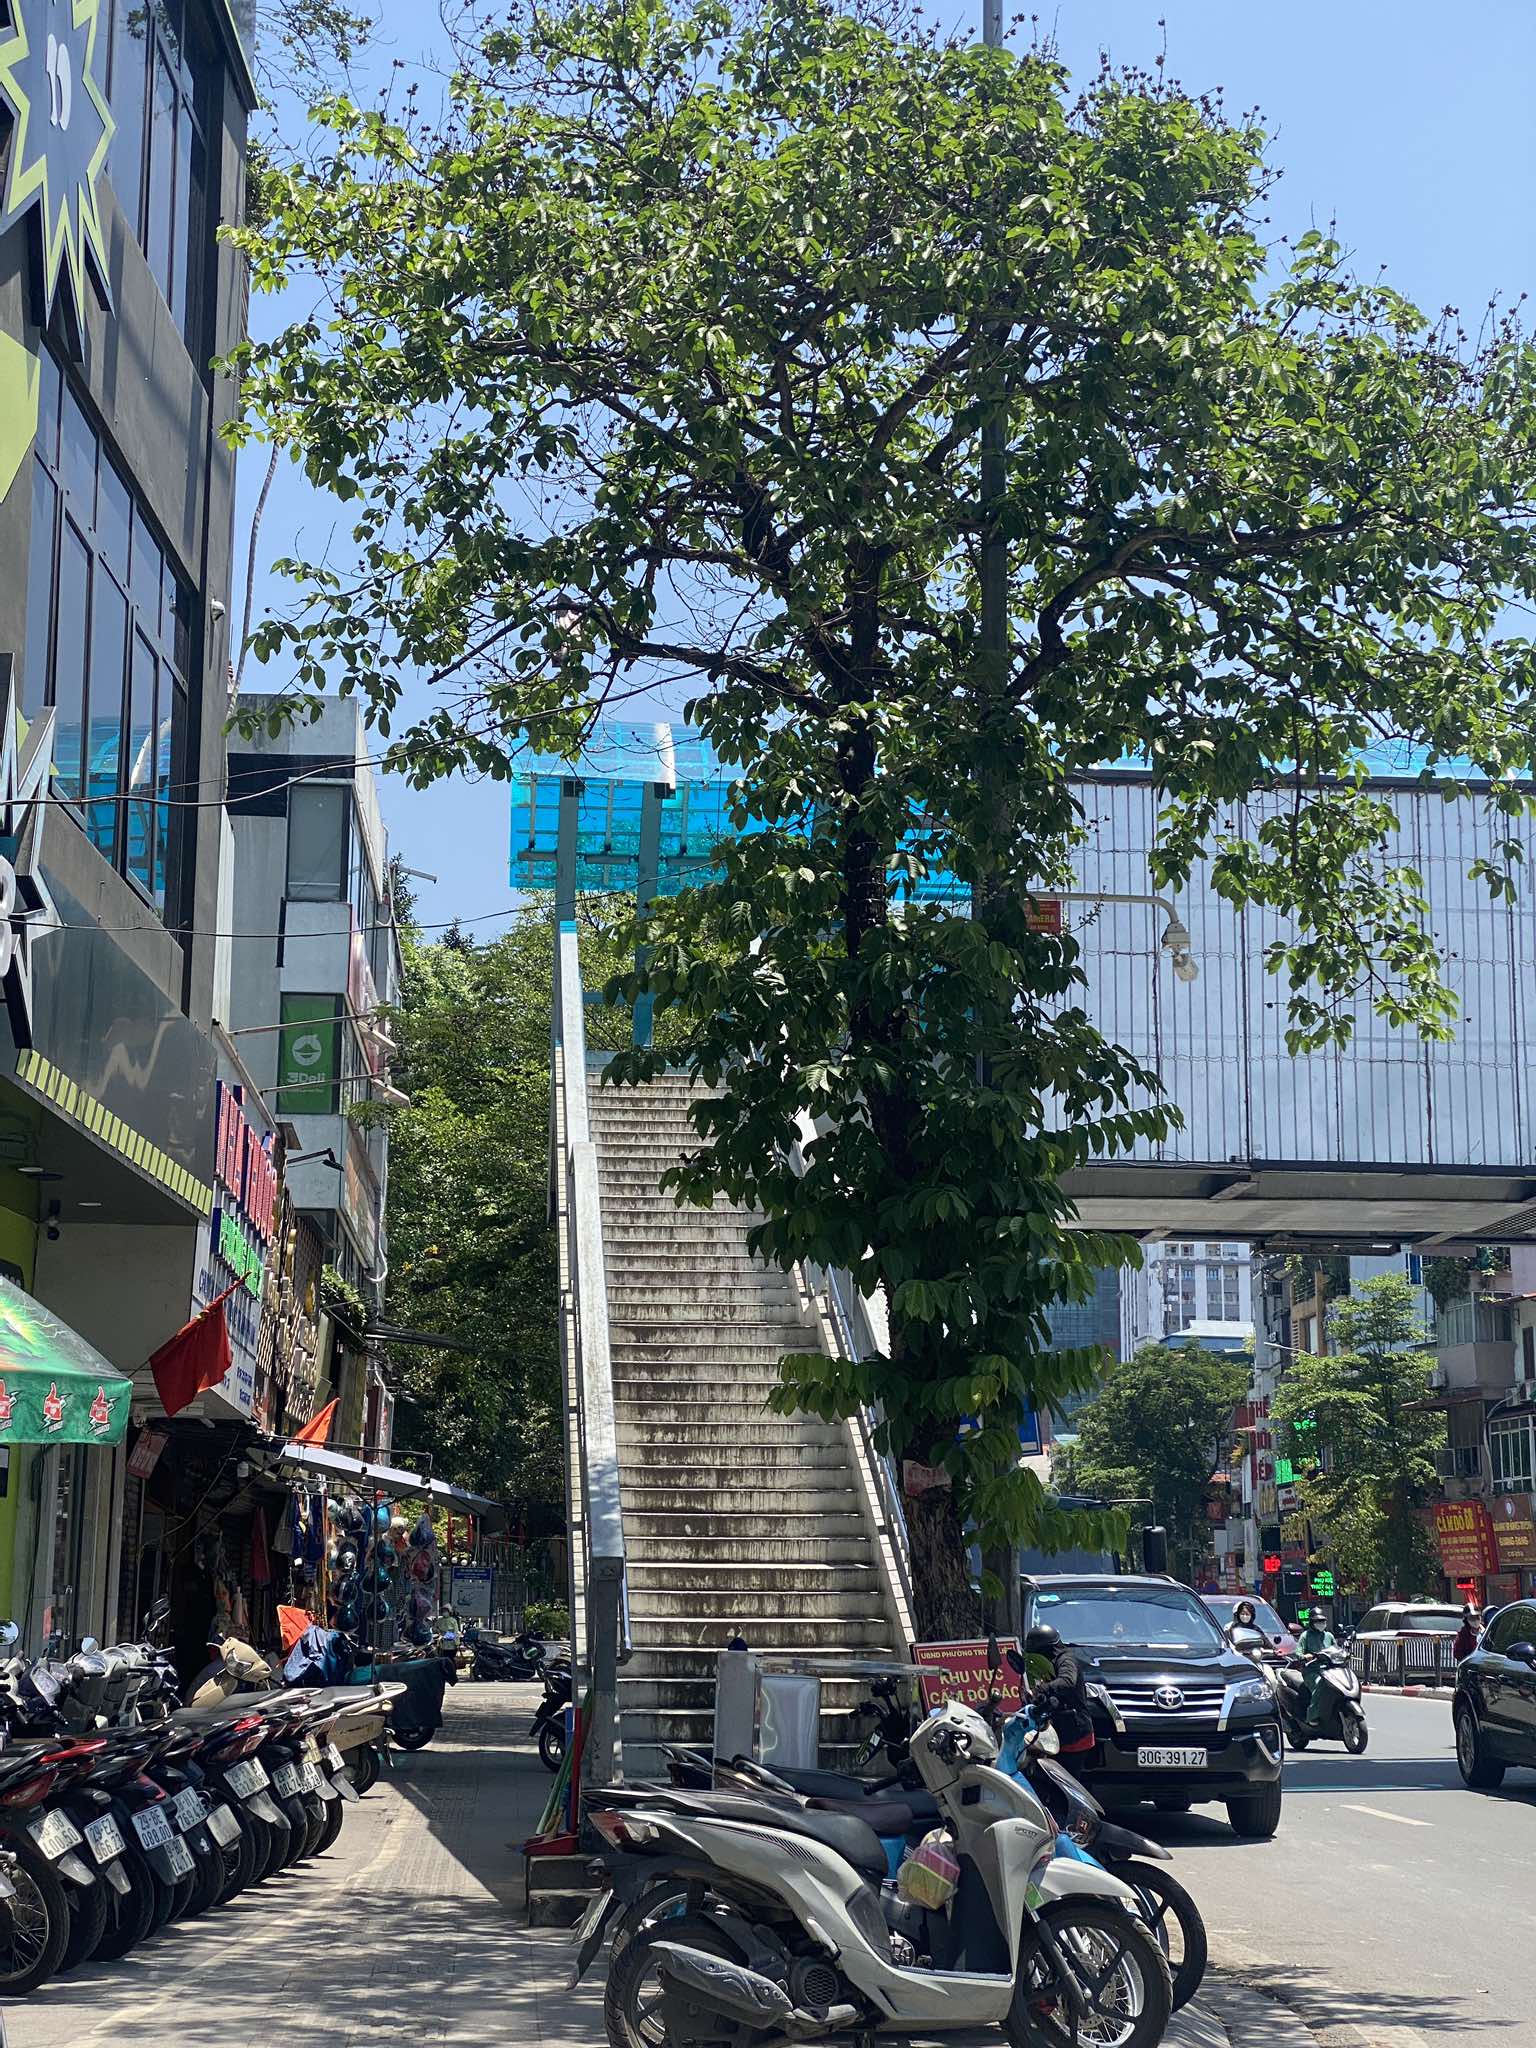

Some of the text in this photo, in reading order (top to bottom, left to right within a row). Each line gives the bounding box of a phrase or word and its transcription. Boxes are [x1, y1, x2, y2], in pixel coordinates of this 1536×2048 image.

[920, 1651, 941, 1660] UBND
[942, 1648, 973, 1659] PHƯỜNG
[940, 1670, 970, 1685] KHU
[1139, 1750, 1205, 1765] 30G-391.27
